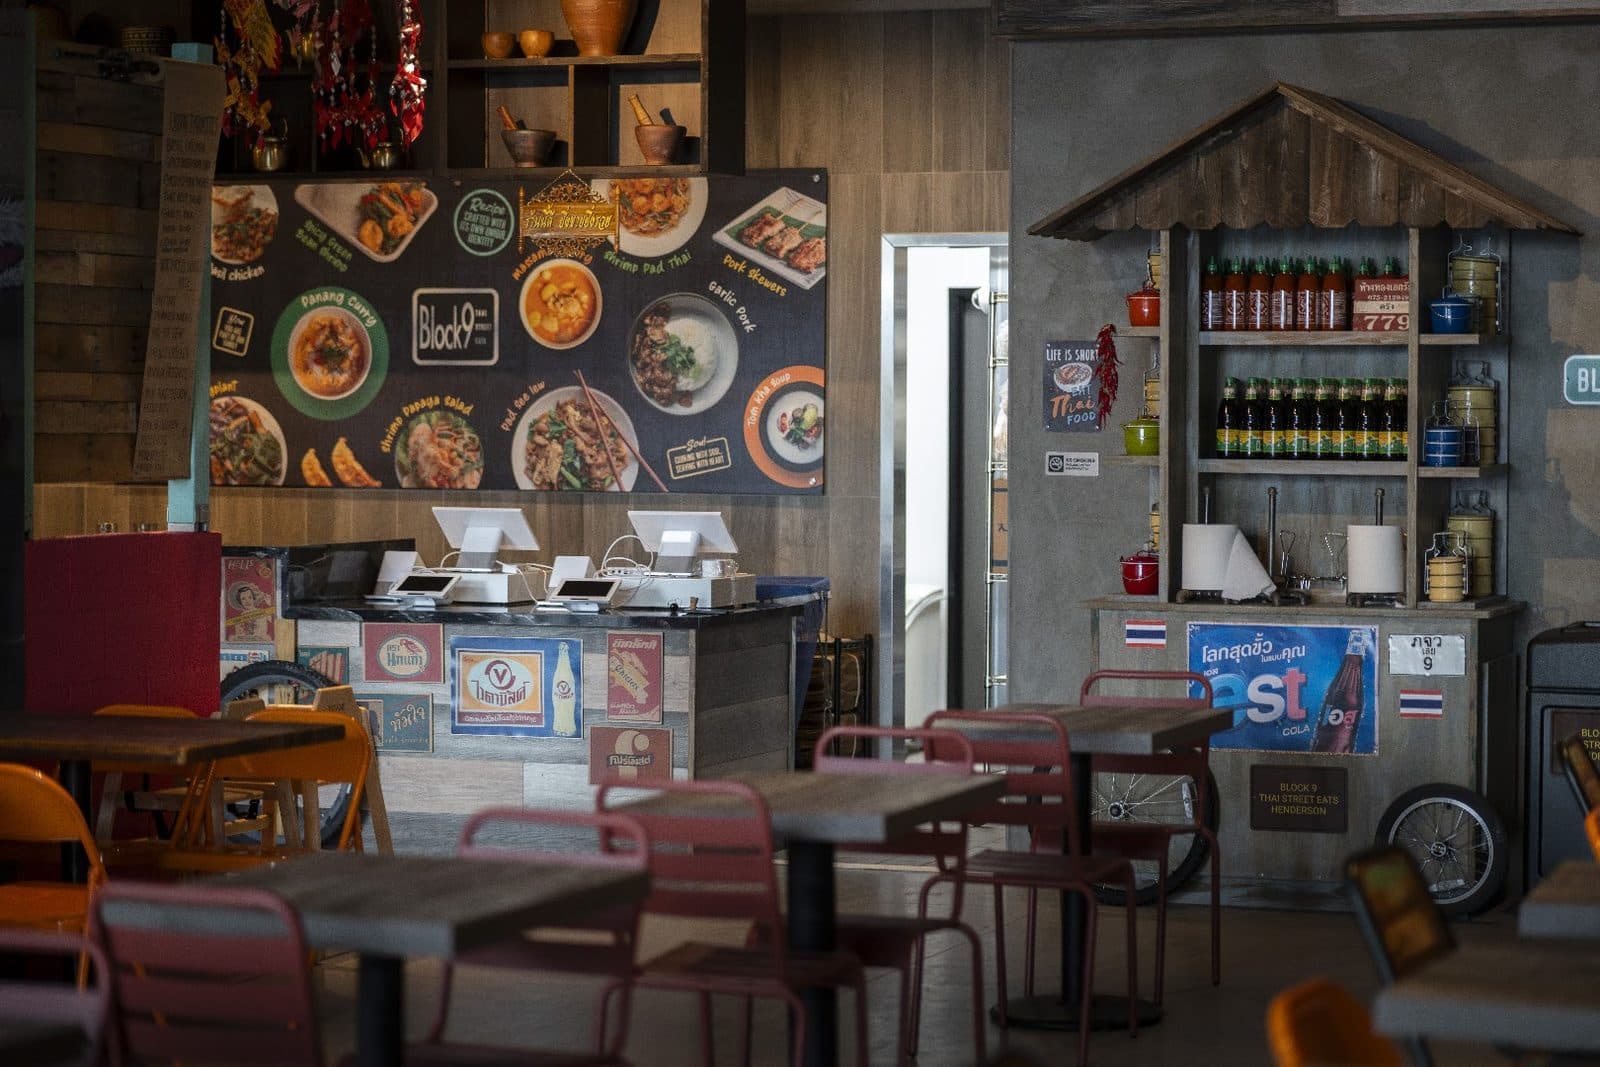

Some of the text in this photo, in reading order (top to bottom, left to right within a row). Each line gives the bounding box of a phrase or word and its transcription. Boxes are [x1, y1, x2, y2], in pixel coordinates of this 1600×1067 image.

[1364, 315, 1409, 331] 779
[1046, 348, 1099, 362] LIFE IS SHORT
[1067, 411, 1096, 425] FOOD
[1202, 632, 1273, 664] โลกสุดขั้ว
[1282, 645, 1306, 664] คุณ
[1423, 656, 1433, 671] 9
[1282, 724, 1311, 737] COLA
[1280, 783, 1318, 793] BLOCK 9
[1258, 793, 1340, 805] THAI STREET EATS
[1271, 805, 1327, 816] HENDERSON
